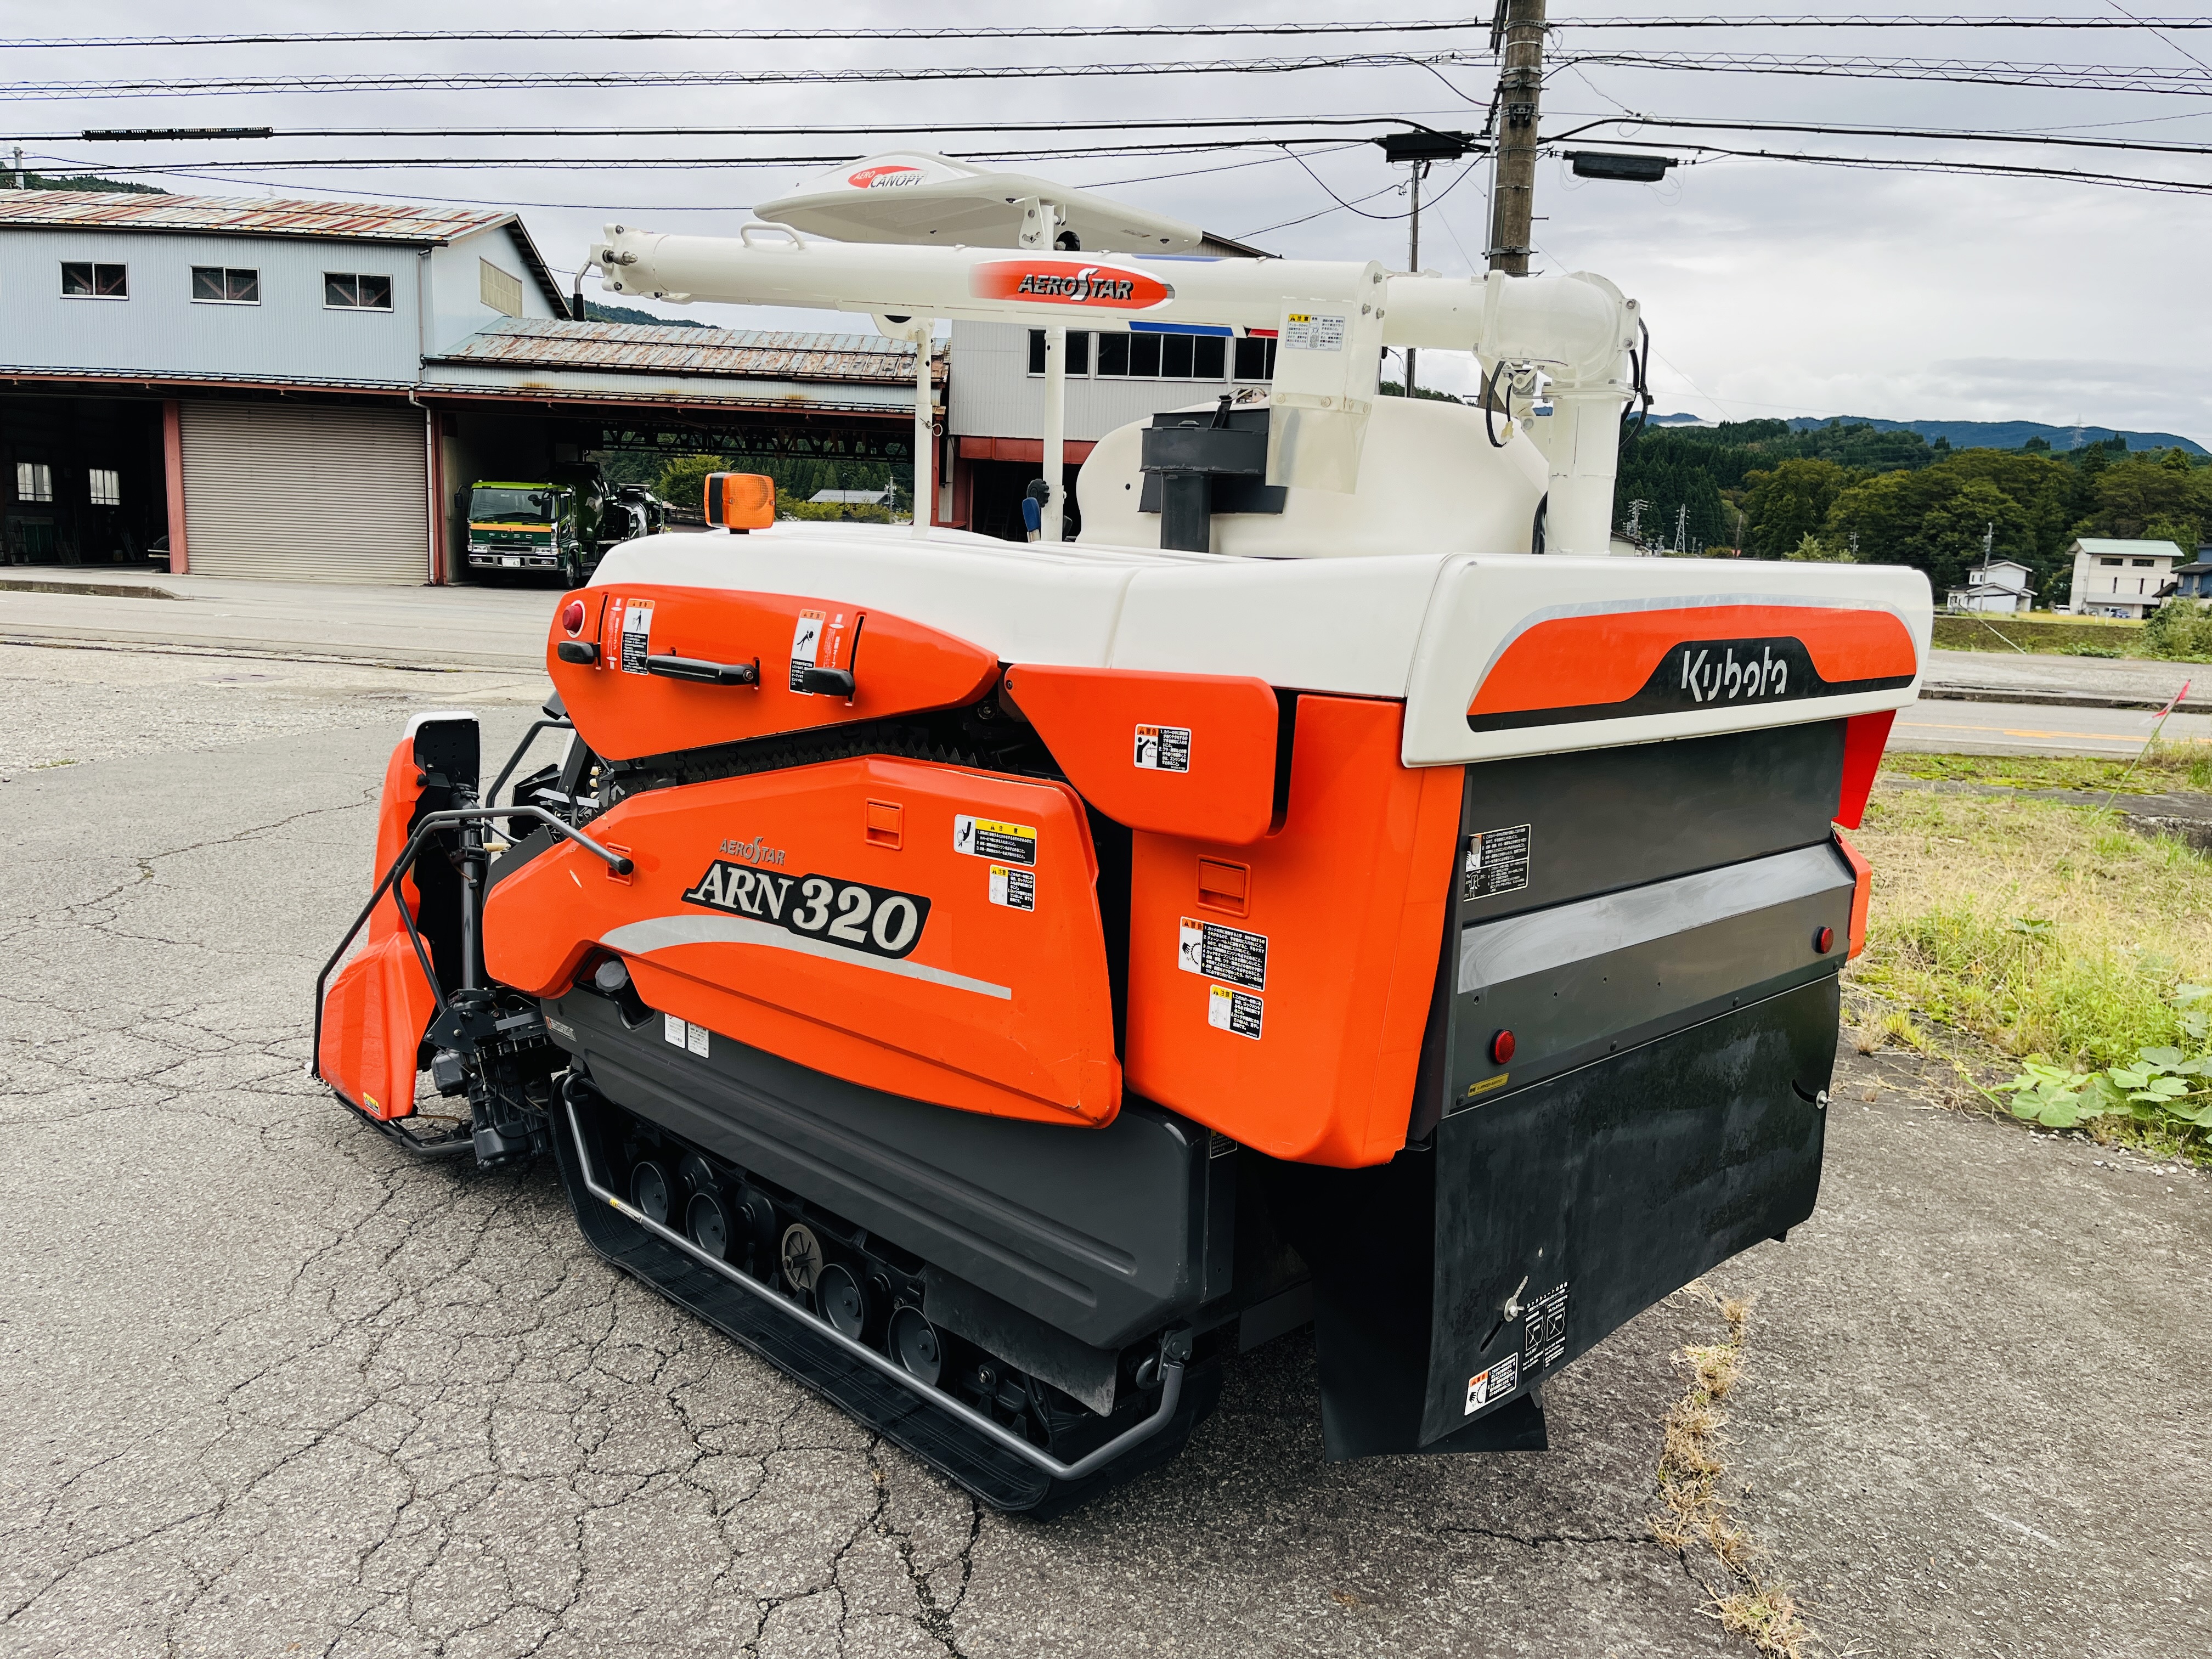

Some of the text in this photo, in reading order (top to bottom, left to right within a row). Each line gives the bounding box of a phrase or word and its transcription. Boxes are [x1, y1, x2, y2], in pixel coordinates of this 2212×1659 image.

[854, 171, 876, 180] AERO
[871, 174, 925, 188] CANOPY
[1681, 646, 1787, 702] Kubota
[686, 863, 918, 951] ARN 320
